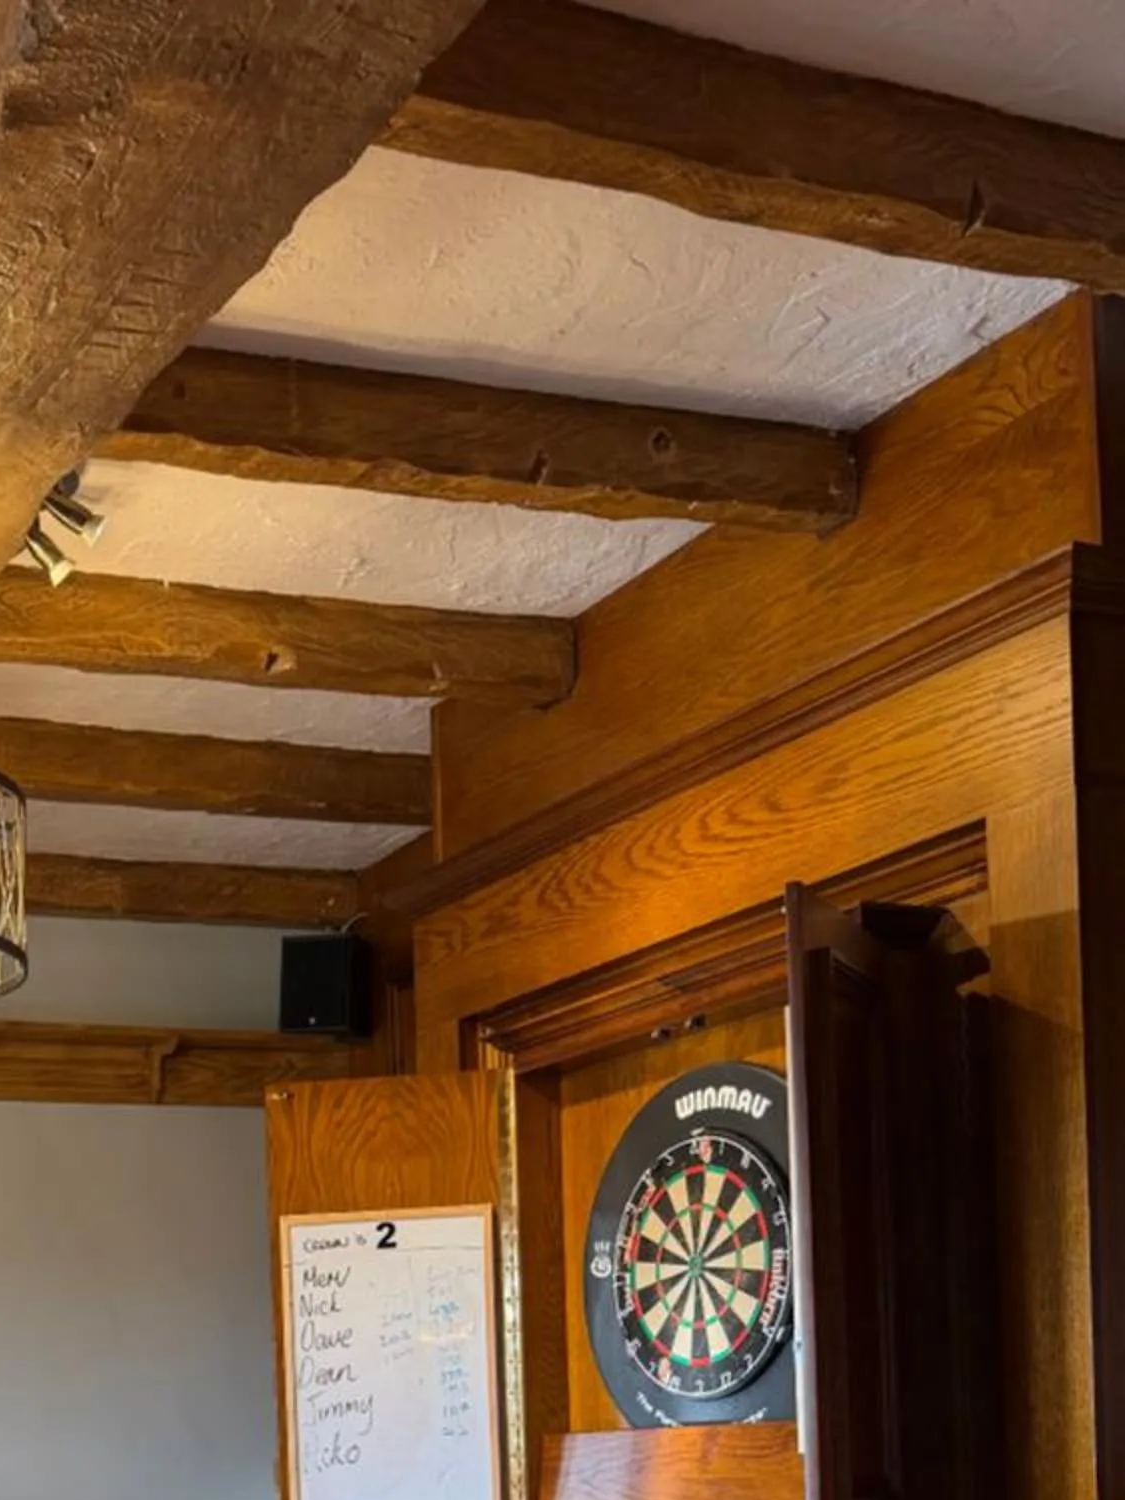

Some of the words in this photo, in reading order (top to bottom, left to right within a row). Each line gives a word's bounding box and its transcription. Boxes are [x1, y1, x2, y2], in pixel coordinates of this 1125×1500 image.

[376, 1222, 398, 1249] 2
[299, 1290, 342, 1319] Nick
[299, 1319, 354, 1352] Dave
